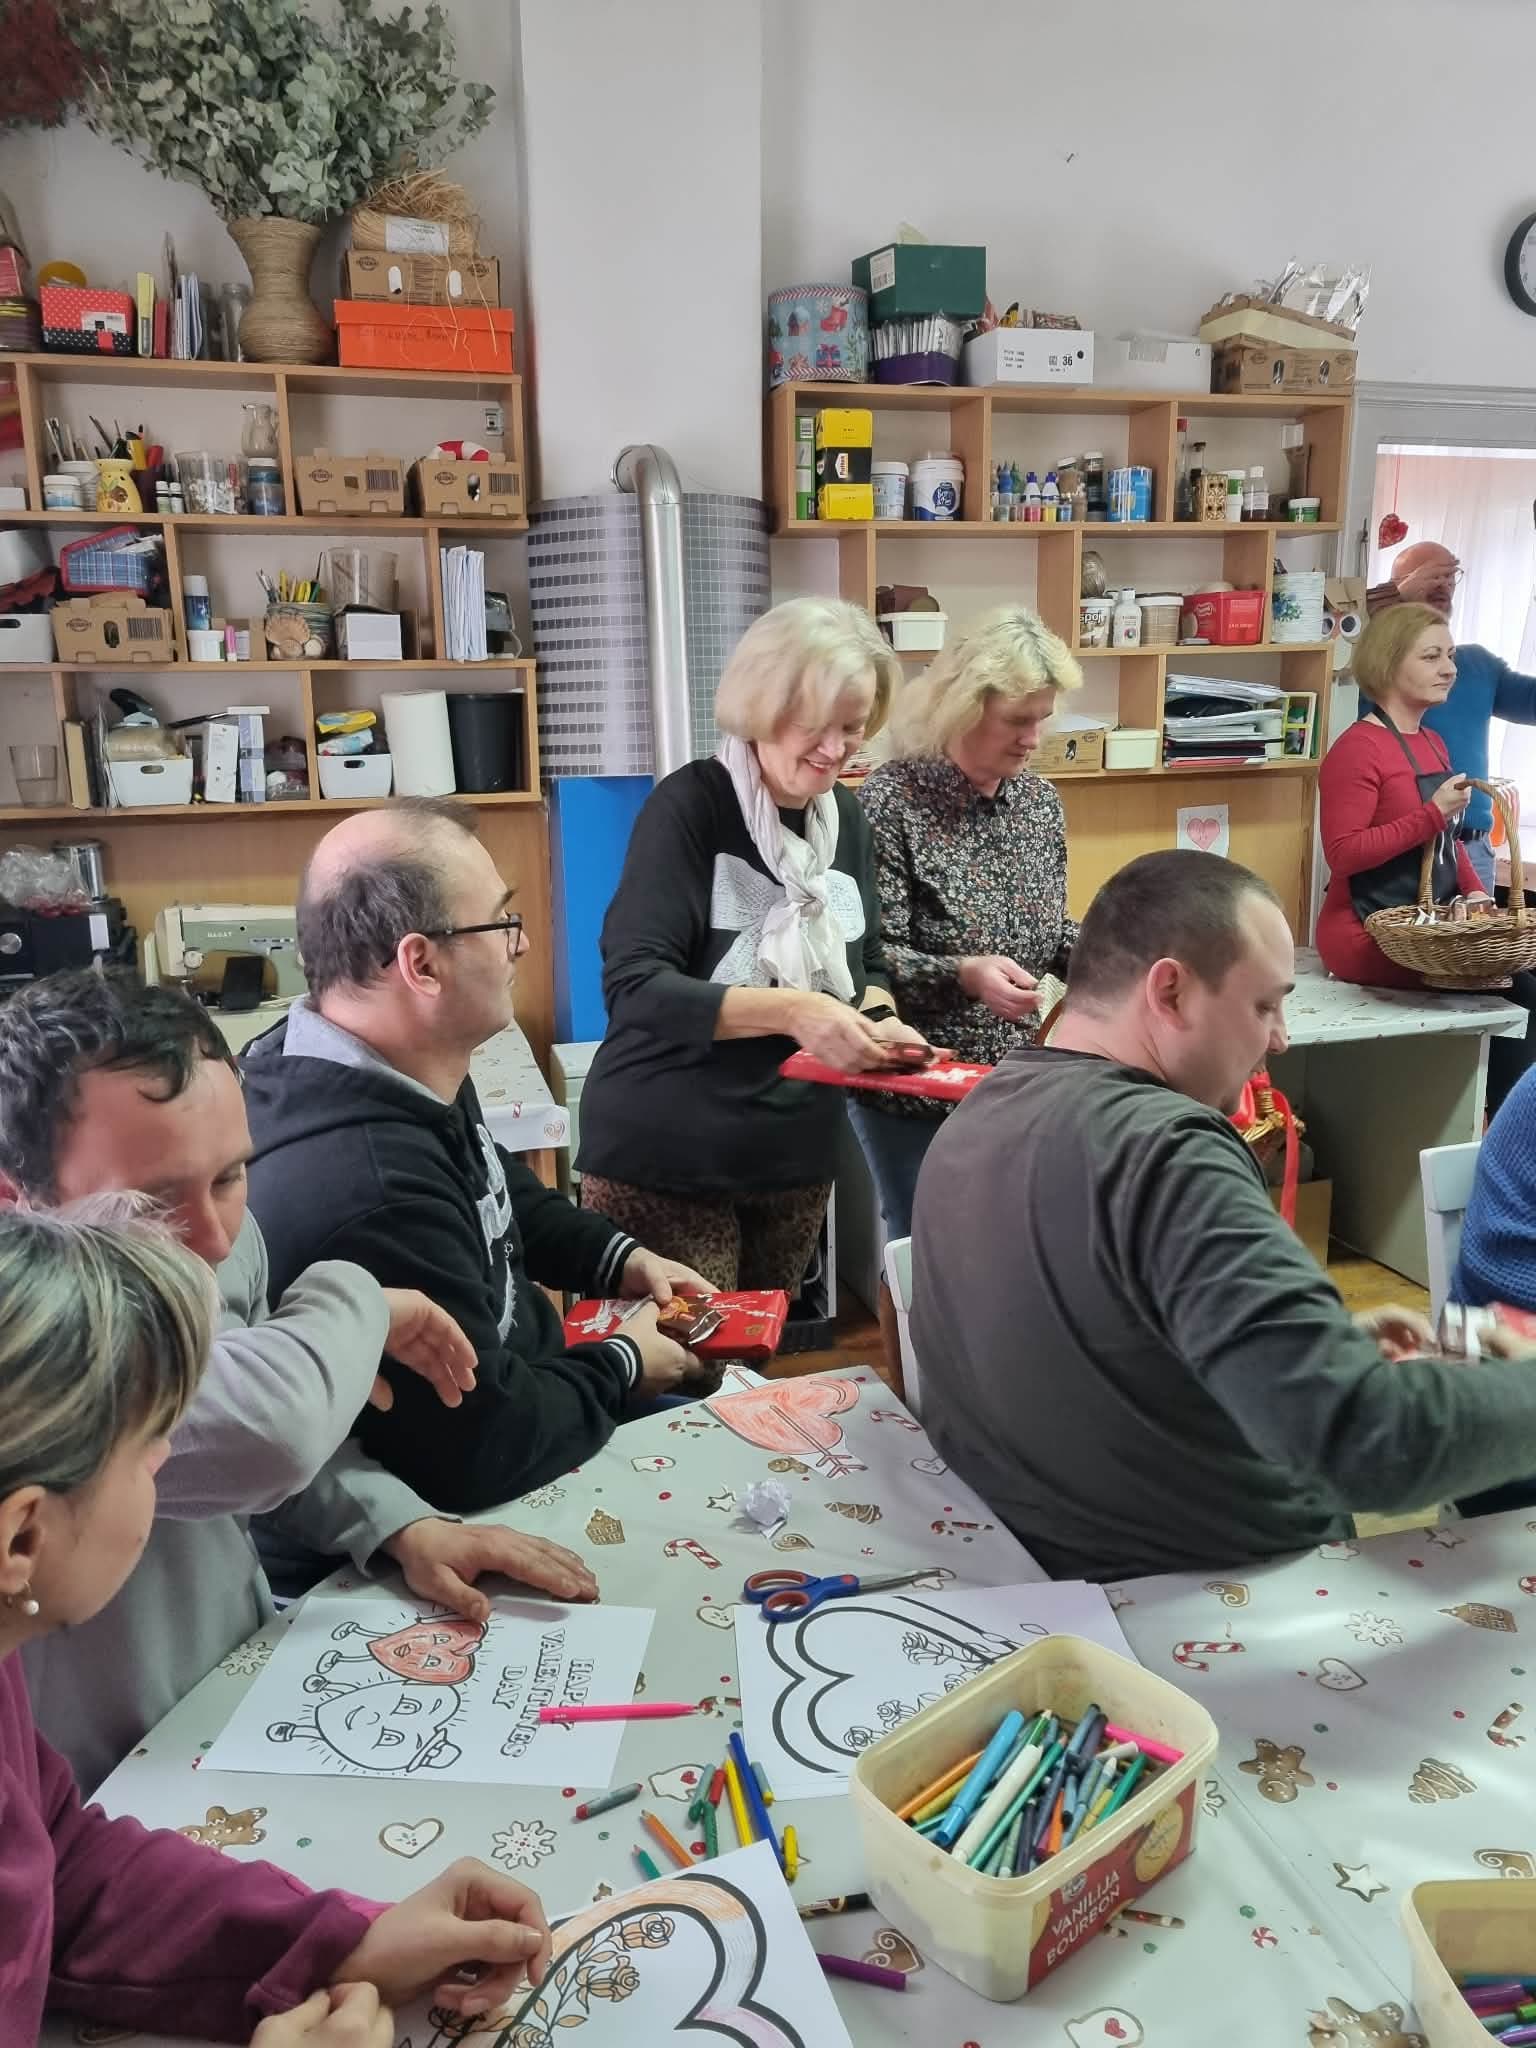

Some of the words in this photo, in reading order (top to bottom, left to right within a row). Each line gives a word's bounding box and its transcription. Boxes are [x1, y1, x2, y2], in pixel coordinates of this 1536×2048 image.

[1062, 356, 1073, 366] 36
[492, 1665, 527, 1709] DAY
[500, 1627, 565, 1757] VALENTINES
[1047, 1884, 1120, 1967] BOURBON
[1051, 1869, 1120, 1936] VANILIJA
